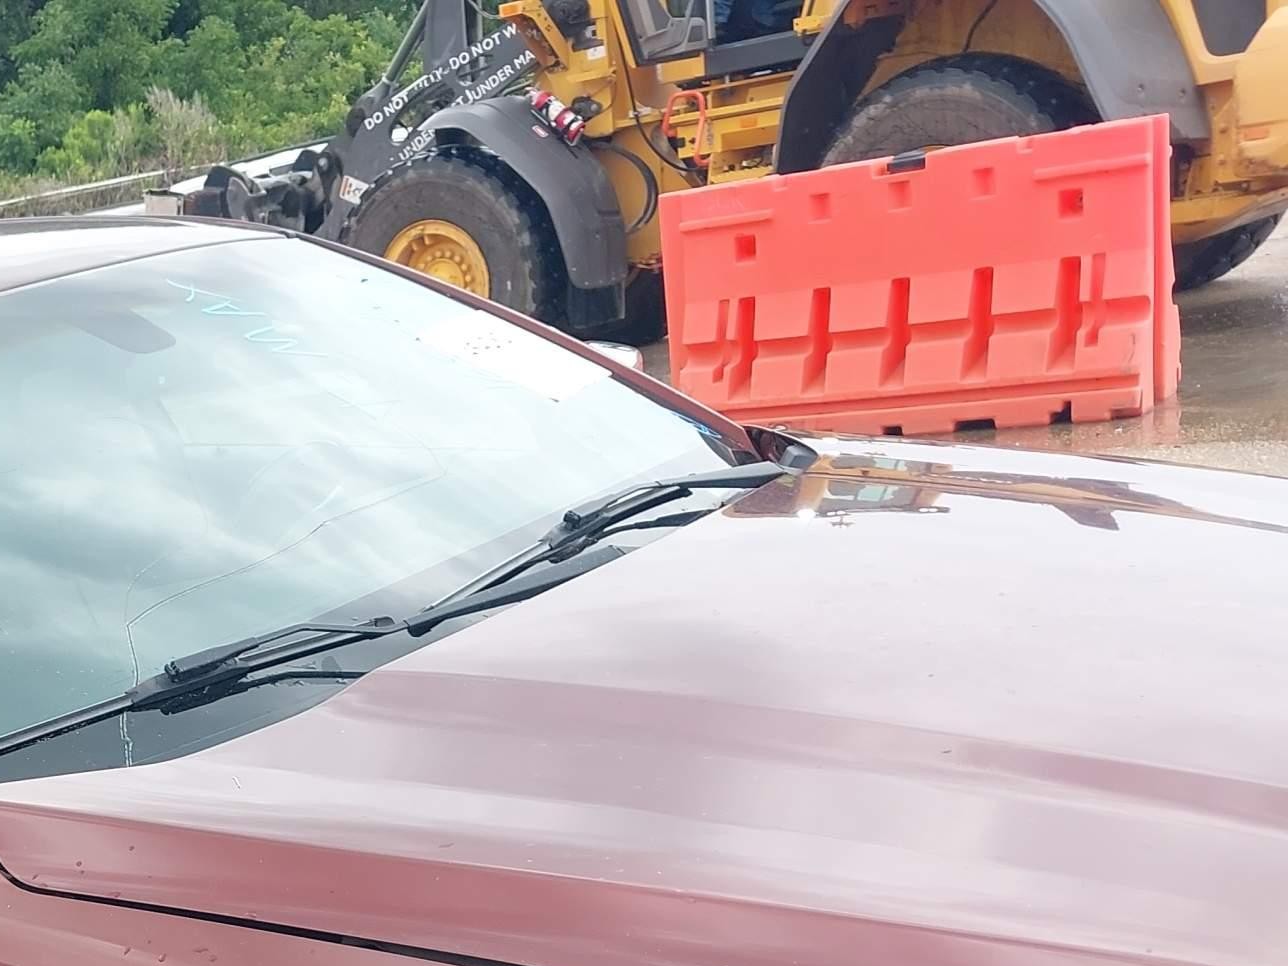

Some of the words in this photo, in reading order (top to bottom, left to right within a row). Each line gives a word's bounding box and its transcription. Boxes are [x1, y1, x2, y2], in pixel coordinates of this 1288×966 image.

[364, 111, 383, 130] DO
[383, 92, 409, 117] NOT
[449, 52, 470, 70] DO
[470, 32, 501, 57] NOT
[502, 23, 520, 39] W
[472, 65, 514, 100] UNDER
